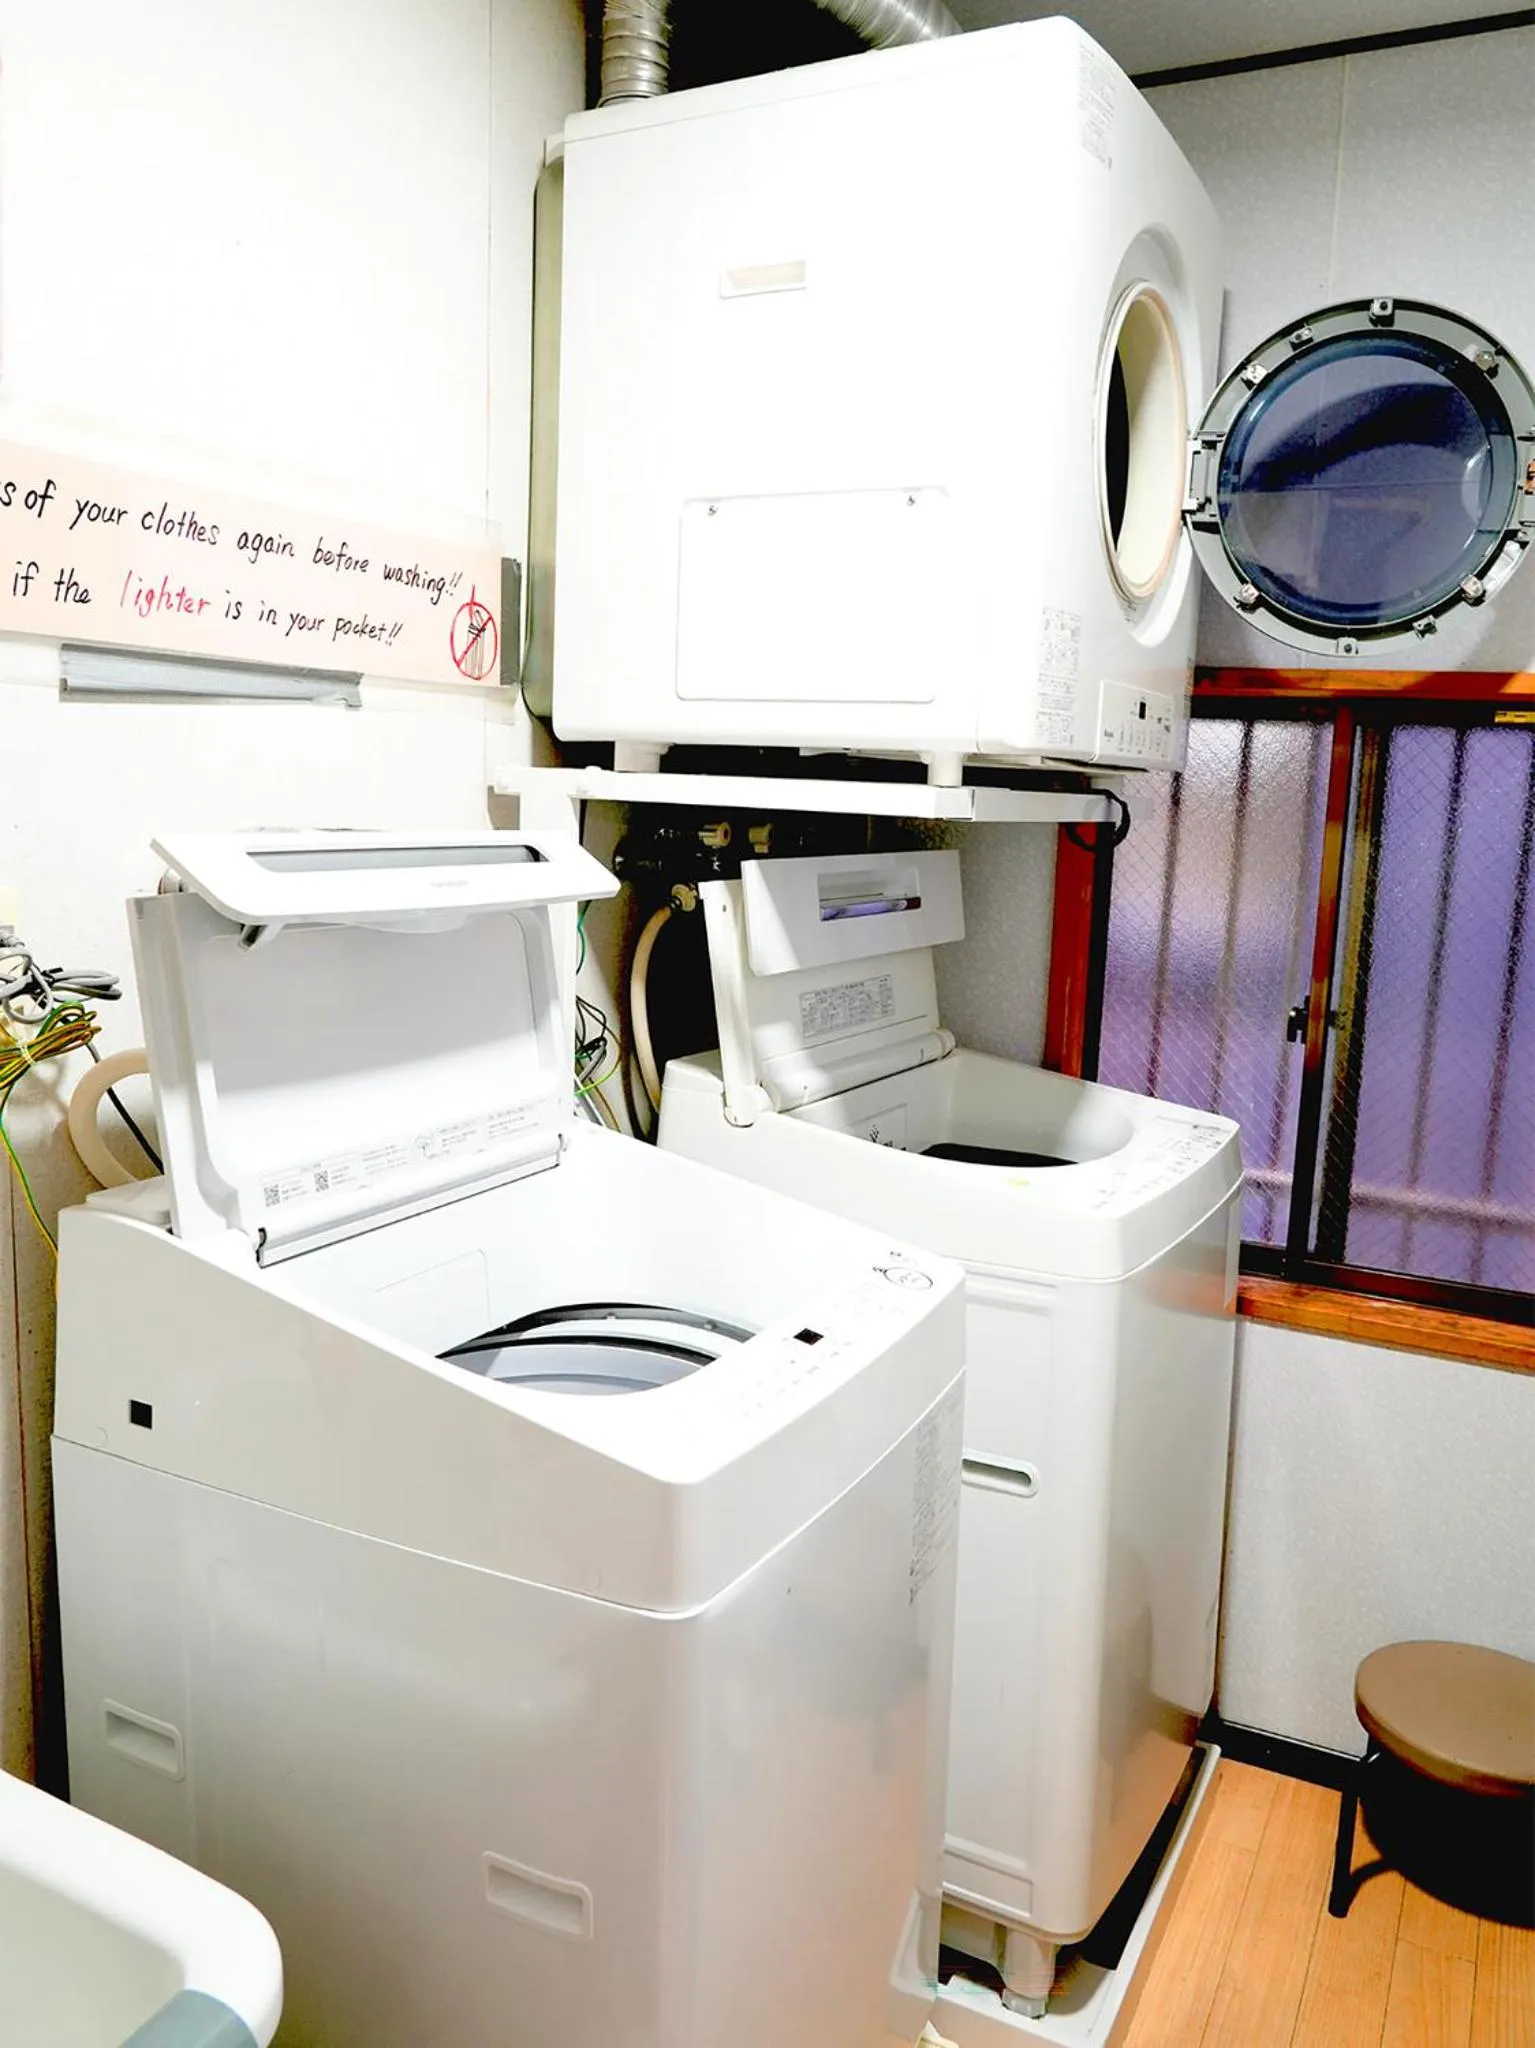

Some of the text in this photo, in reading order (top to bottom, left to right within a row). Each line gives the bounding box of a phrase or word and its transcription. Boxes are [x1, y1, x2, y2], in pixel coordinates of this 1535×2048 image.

[24, 479, 56, 518] of
[69, 499, 128, 531] your
[141, 502, 220, 545] clothes
[237, 531, 295, 564] again
[312, 536, 370, 573] before
[383, 563, 463, 606] washing!!
[13, 560, 403, 647] if the lighter is in your pocket!!
